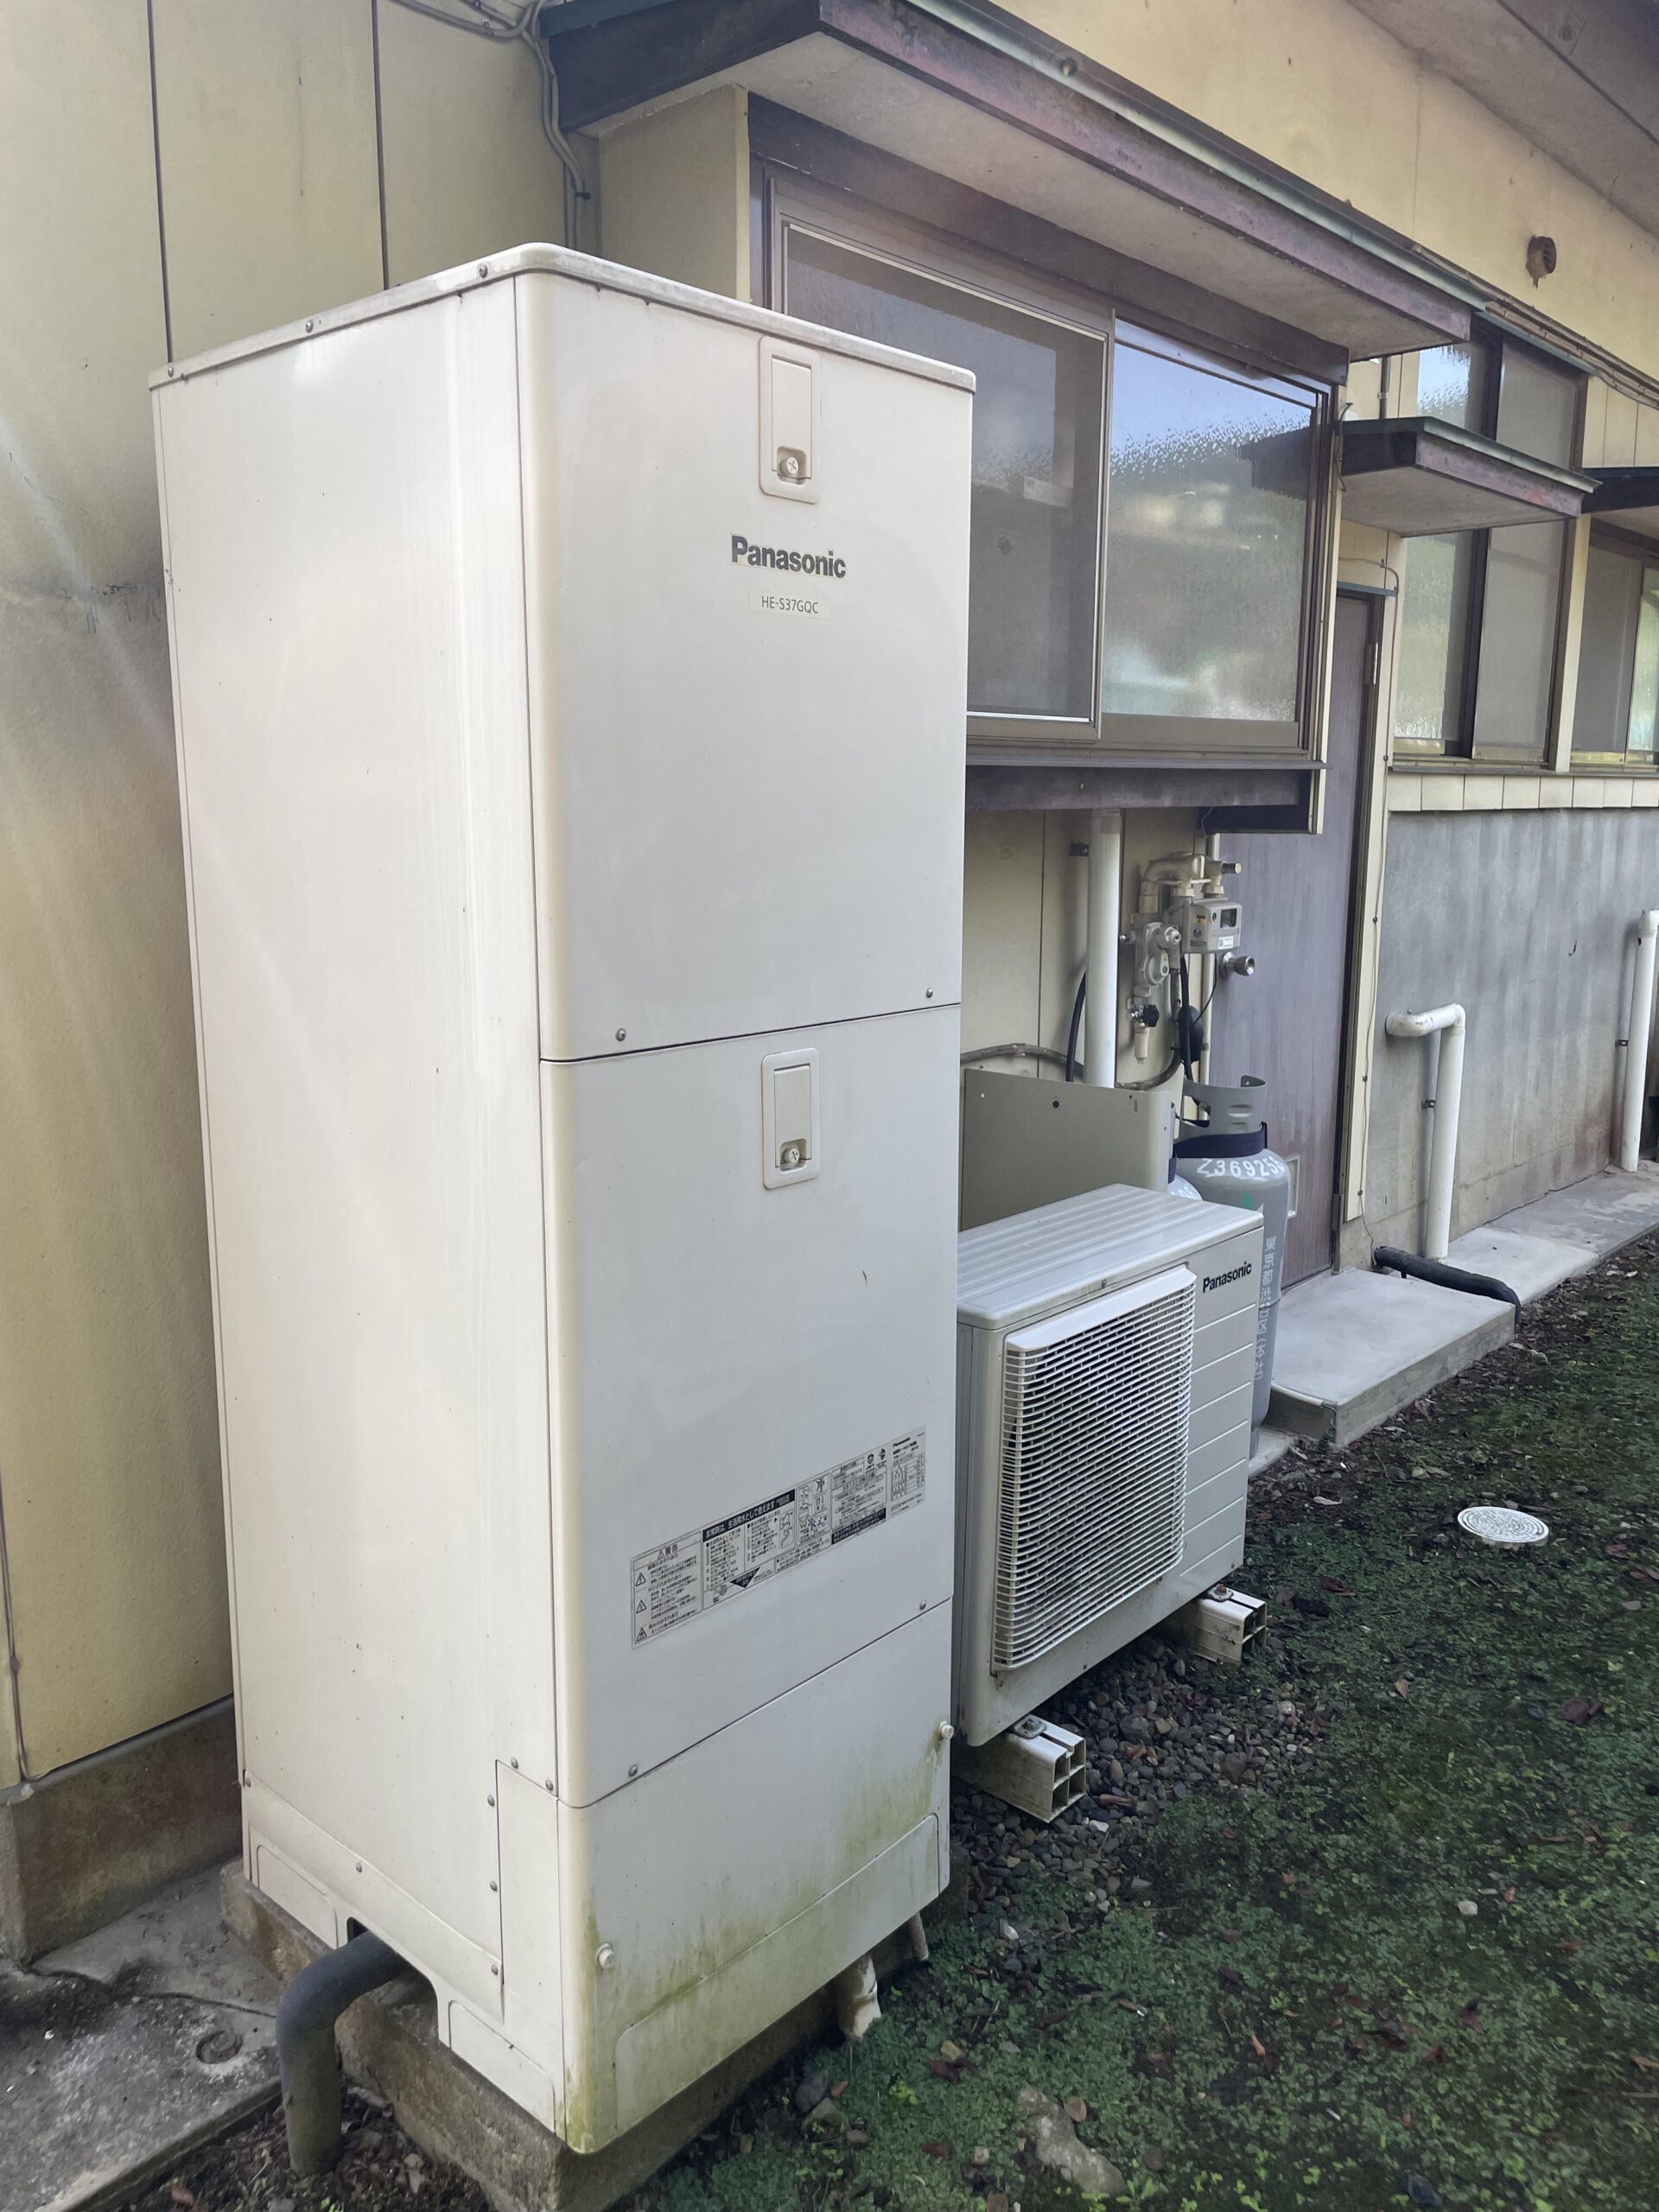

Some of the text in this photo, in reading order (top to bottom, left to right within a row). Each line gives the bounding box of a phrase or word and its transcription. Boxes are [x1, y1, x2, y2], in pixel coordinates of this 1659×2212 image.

[731, 534, 846, 579] Panasonic
[761, 595, 819, 614] HE-S37GQC
[1203, 1261, 1252, 1294] Panasonic
